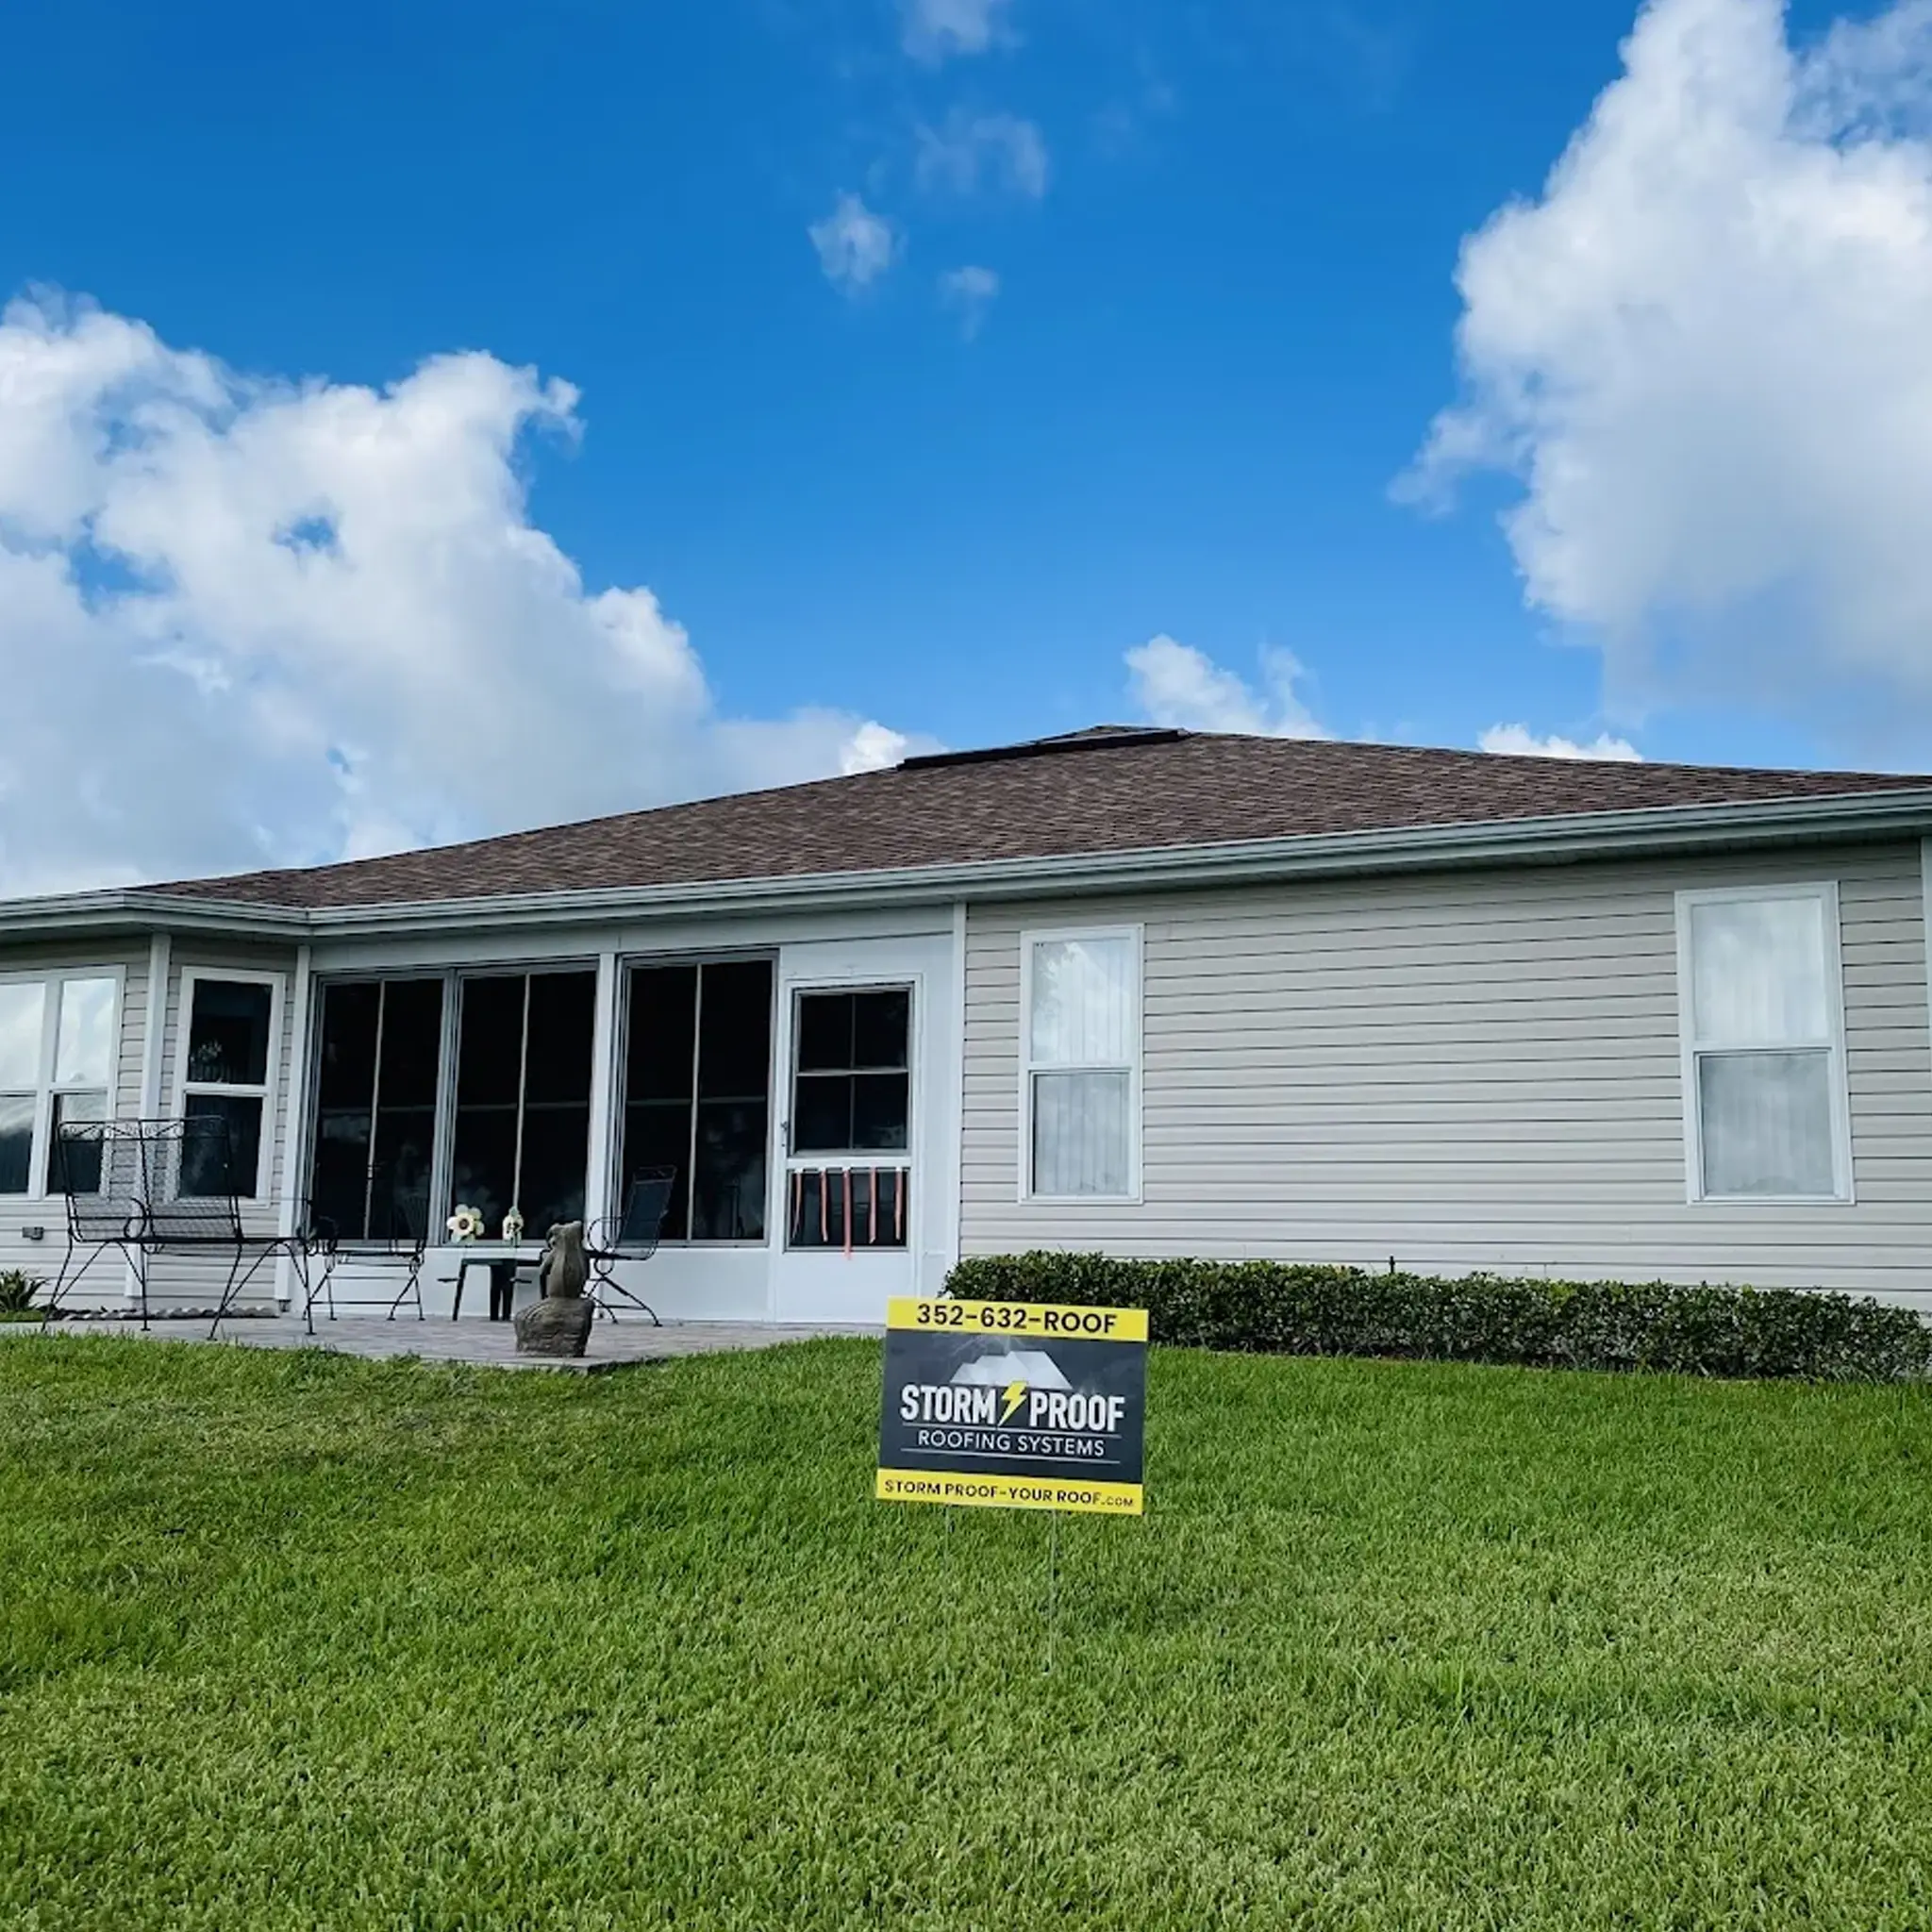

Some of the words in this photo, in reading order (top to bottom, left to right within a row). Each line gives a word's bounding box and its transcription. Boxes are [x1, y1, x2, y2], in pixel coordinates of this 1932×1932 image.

[917, 1304, 1118, 1333] 352-632-ROOF
[900, 1384, 997, 1424] STORM
[1029, 1391, 1125, 1432] PROOF
[918, 1429, 1010, 1452] ROOFING
[1018, 1436, 1105, 1457] SYSTEMS
[884, 1479, 941, 1495] STORM
